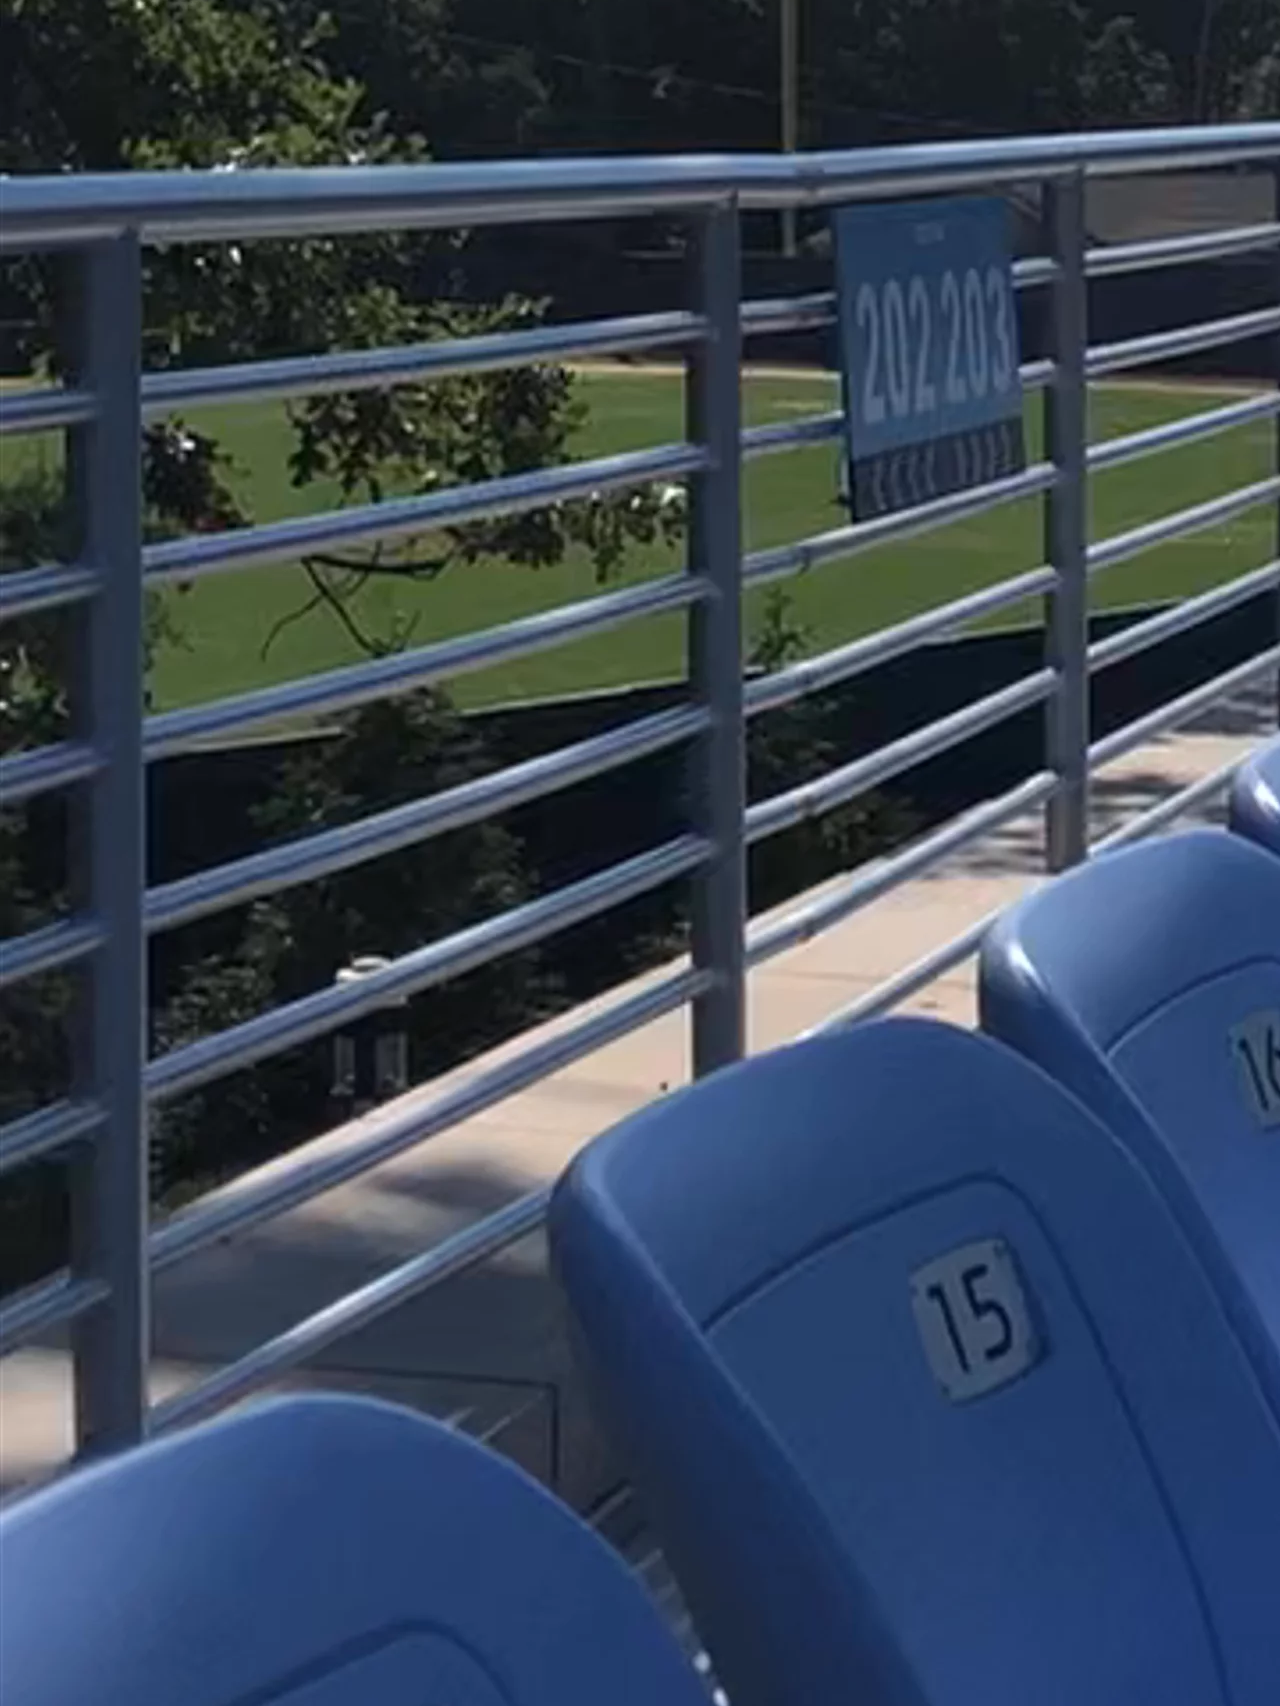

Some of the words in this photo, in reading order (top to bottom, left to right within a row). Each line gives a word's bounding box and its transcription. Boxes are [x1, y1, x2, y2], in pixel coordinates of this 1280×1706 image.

[856, 274, 935, 424] 202
[941, 266, 1012, 404] 203
[926, 1264, 1012, 1375] 15
